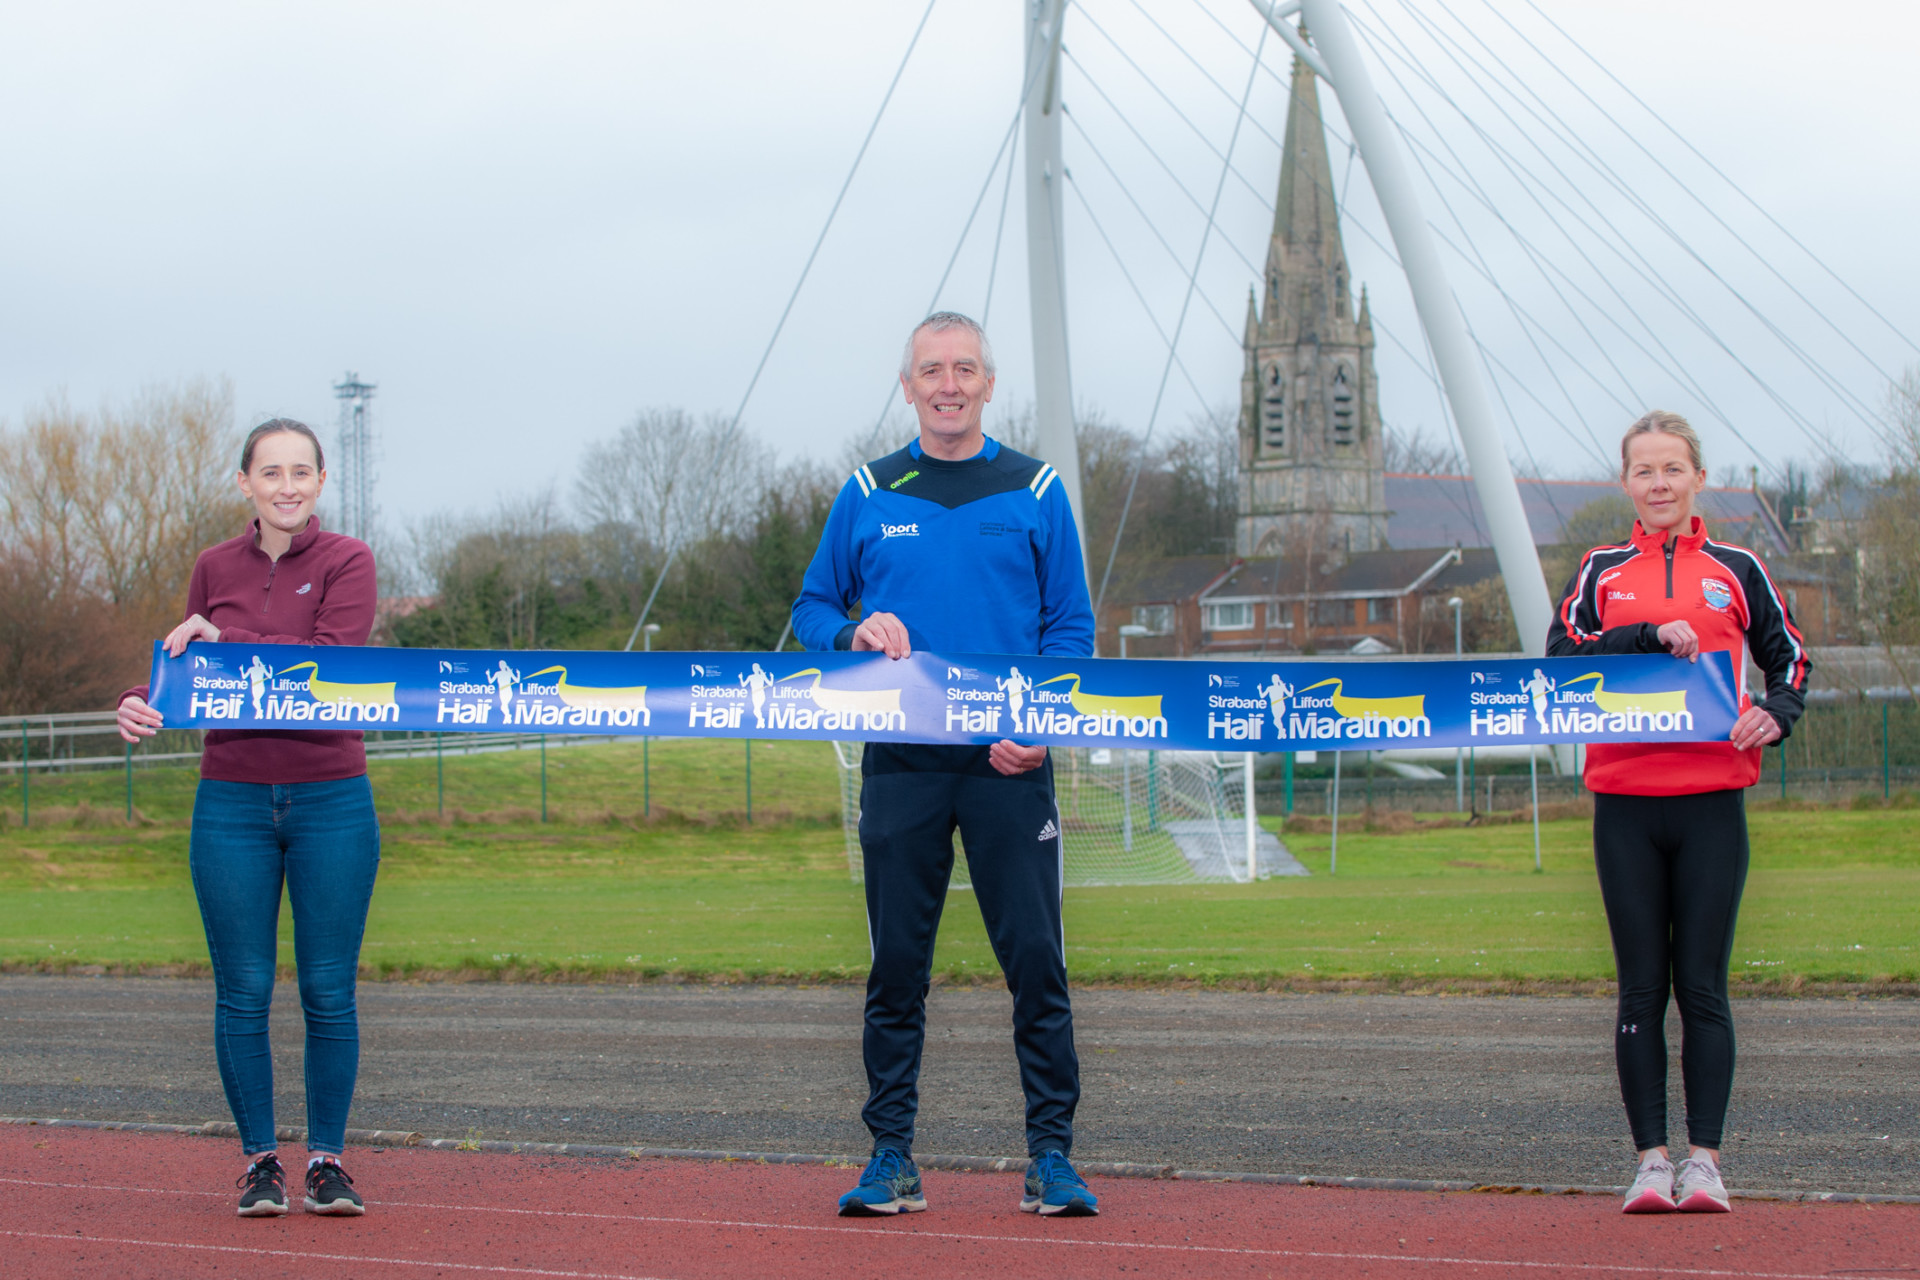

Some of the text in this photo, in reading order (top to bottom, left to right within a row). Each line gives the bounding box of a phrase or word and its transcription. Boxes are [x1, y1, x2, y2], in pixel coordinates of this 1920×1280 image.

[193, 676, 310, 692] Strabane Lifford
[439, 681, 559, 696] Strabane Lifford
[691, 685, 813, 699] Strabane Lifford
[190, 692, 400, 722] Half Marathon
[946, 688, 1071, 704] Strabane Lifford
[1208, 695, 1334, 709] Strabane Lifford
[1470, 691, 1595, 705] Strabane Lifford
[437, 698, 650, 727] Half Marathon
[688, 702, 906, 731] Half Marathon
[945, 705, 1168, 738] Half Marathon
[1470, 706, 1693, 735] Half Marathon
[1208, 711, 1430, 739] Half Marathon
